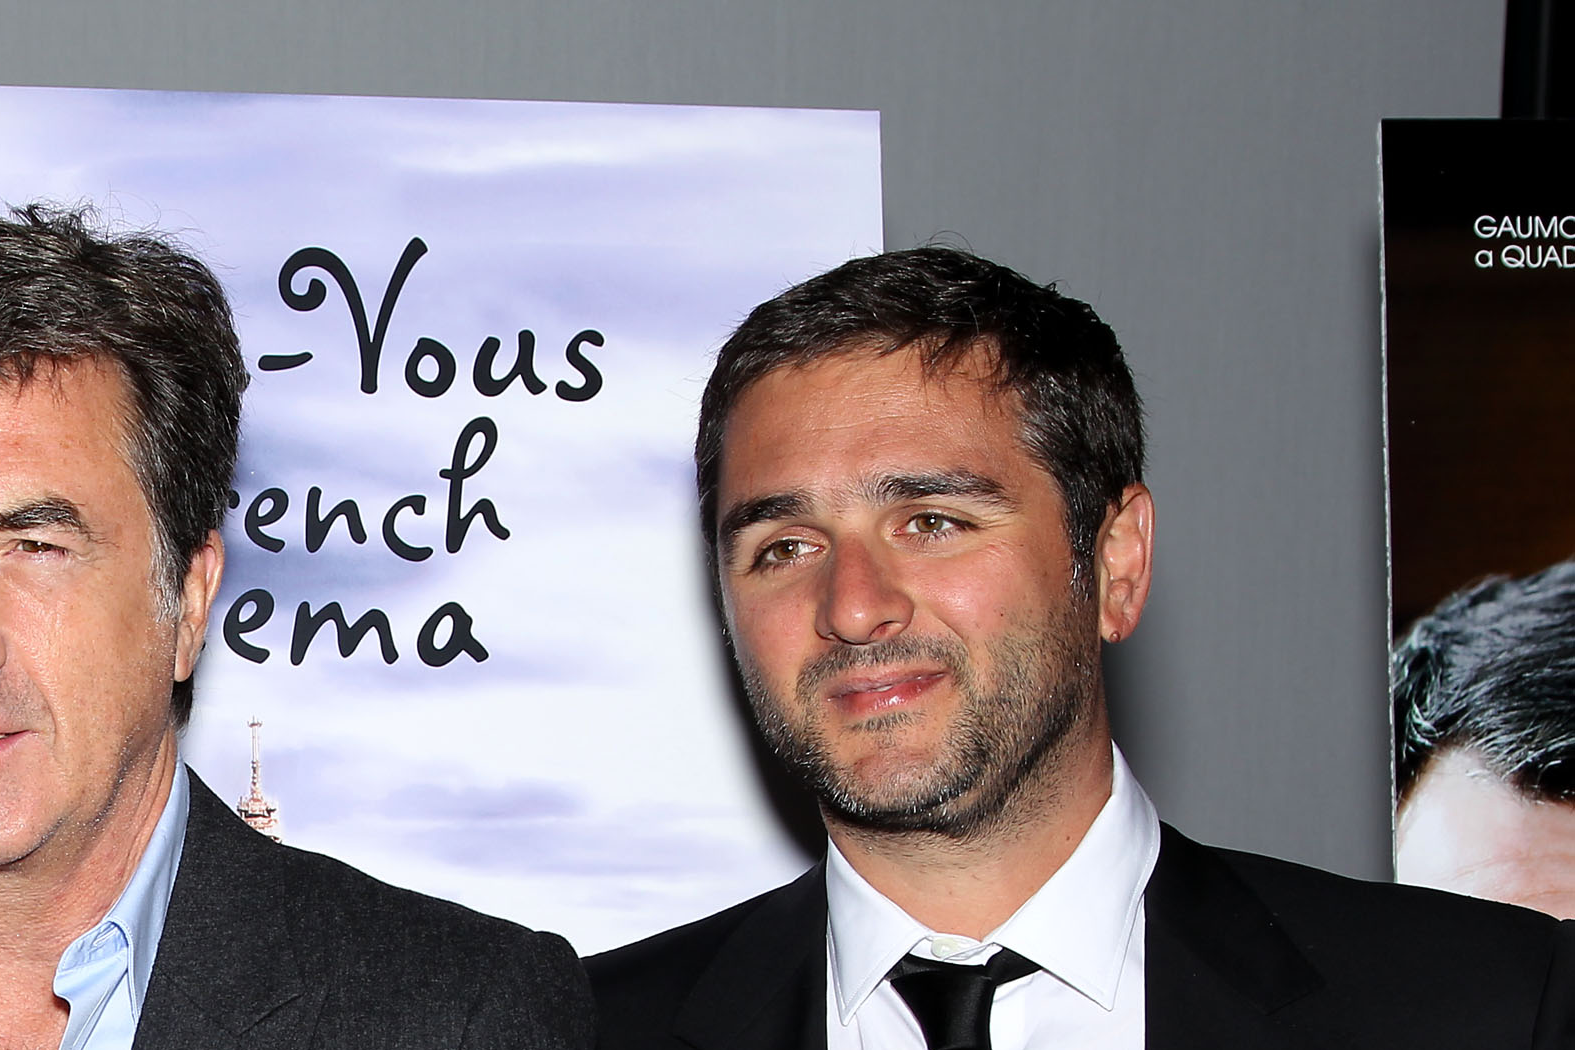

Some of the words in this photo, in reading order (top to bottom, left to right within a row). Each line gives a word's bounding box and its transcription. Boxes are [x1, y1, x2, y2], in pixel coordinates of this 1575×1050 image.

[1474, 214, 1575, 239] GAUMO
[1474, 249, 1494, 268] a
[228, 416, 511, 563] ench
[223, 588, 490, 667] ema
